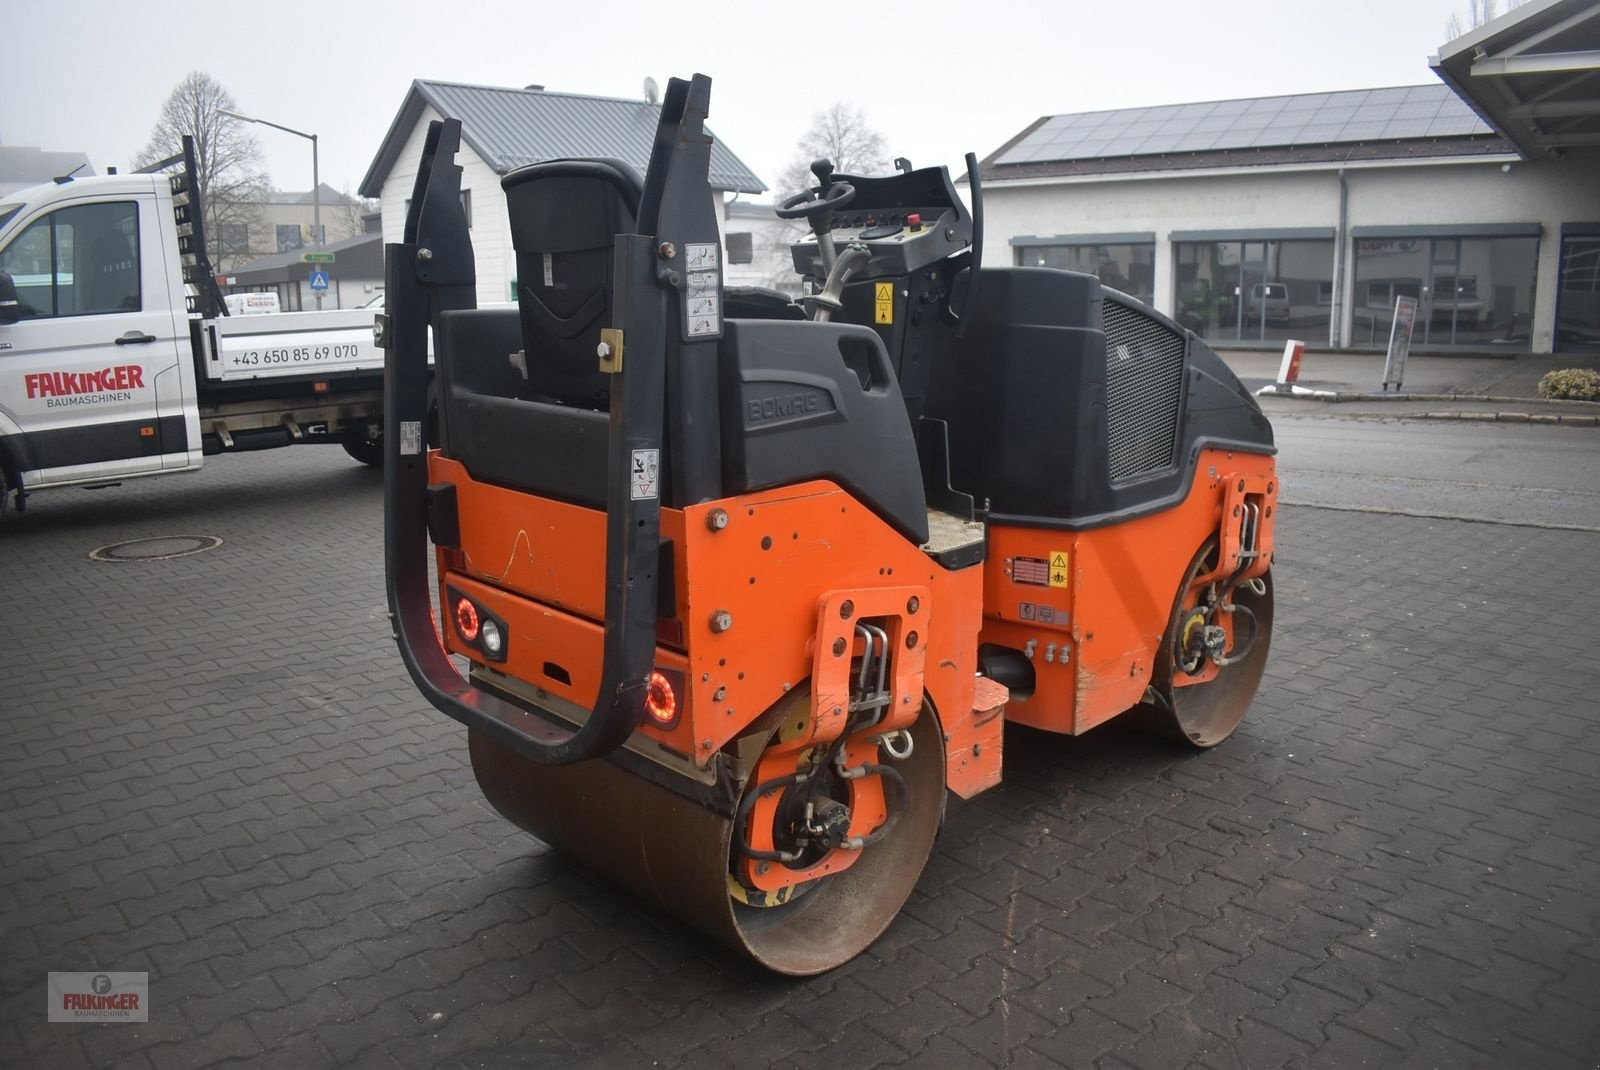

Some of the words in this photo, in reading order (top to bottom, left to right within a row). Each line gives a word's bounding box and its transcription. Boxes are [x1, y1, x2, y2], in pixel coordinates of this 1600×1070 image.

[233, 352, 259, 366] +43
[263, 349, 289, 364] 650
[293, 348, 310, 361] 85
[314, 346, 330, 360] 69
[334, 344, 358, 359] 070
[24, 364, 145, 399] FALKINGER
[47, 391, 131, 408] BAUMASCHINEN
[745, 392, 818, 420] BOMAG
